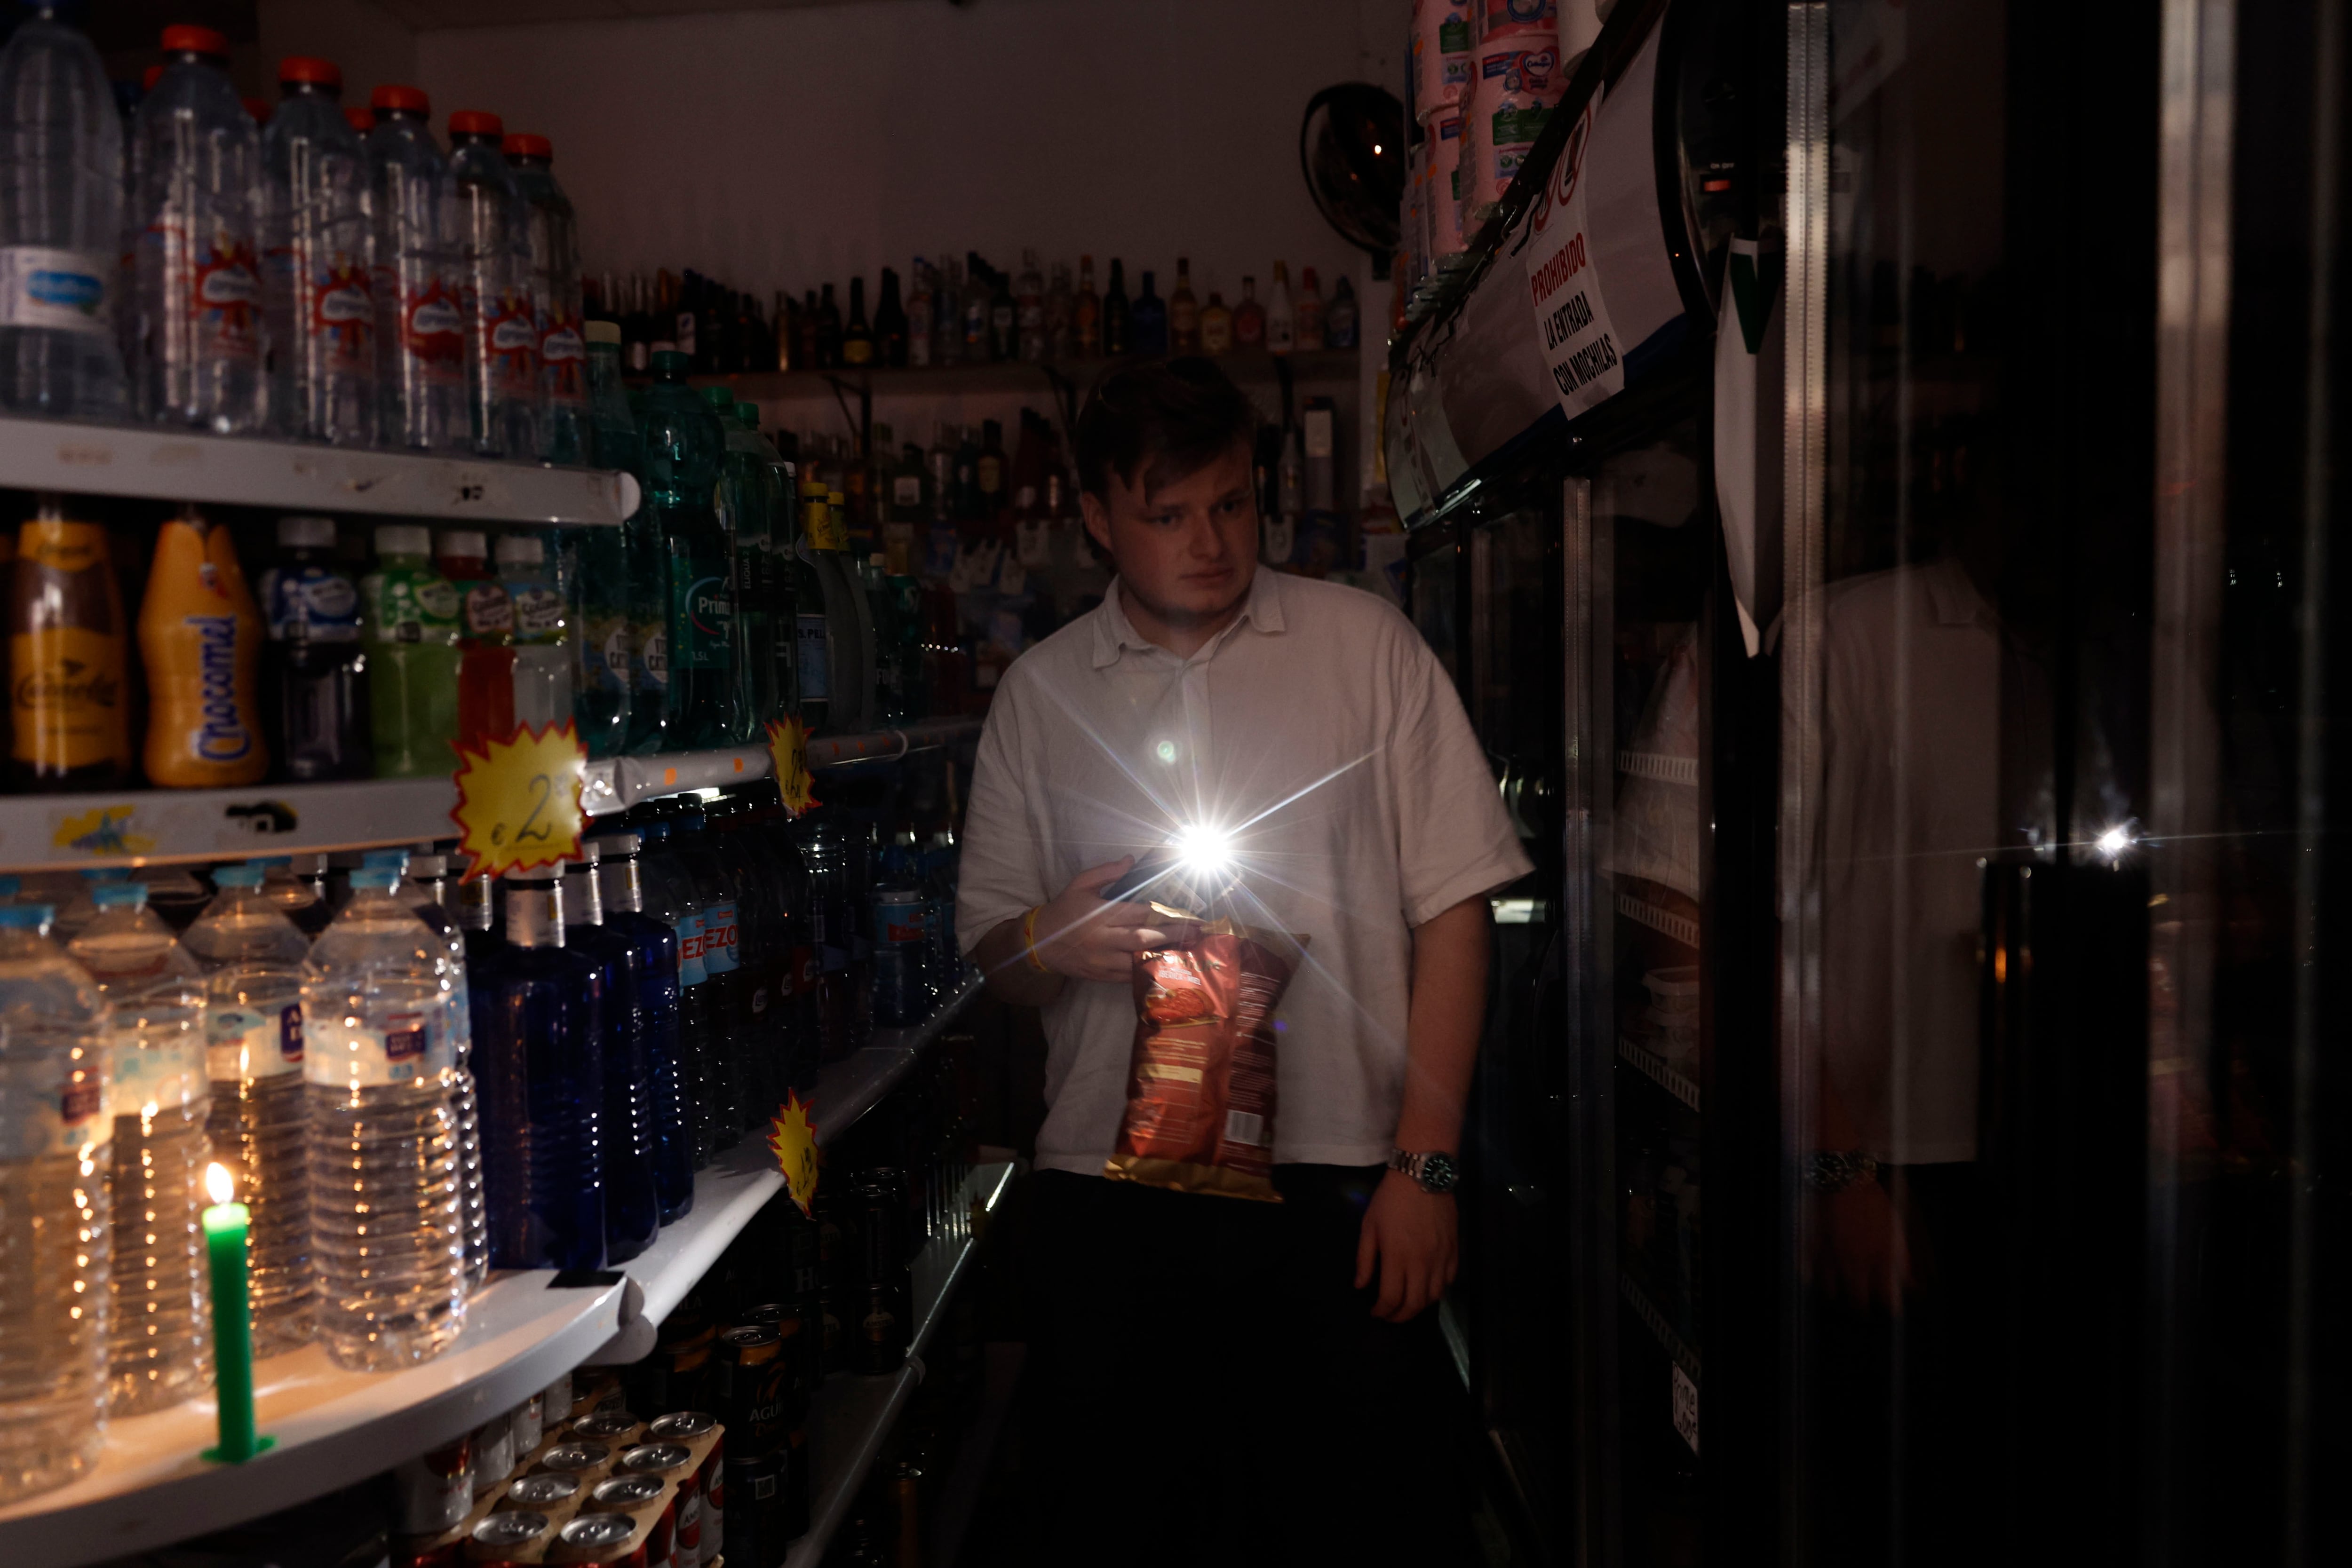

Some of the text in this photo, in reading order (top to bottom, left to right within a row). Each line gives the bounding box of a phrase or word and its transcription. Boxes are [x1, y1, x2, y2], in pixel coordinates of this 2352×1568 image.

[1531, 232, 1586, 307] PROHIBIDO
[1544, 291, 1594, 350] LA ENTRADA
[1553, 333, 1618, 396] CON MOCHILAS
[705, 924, 739, 949] EZO
[748, 1400, 783, 1423] AGUI
